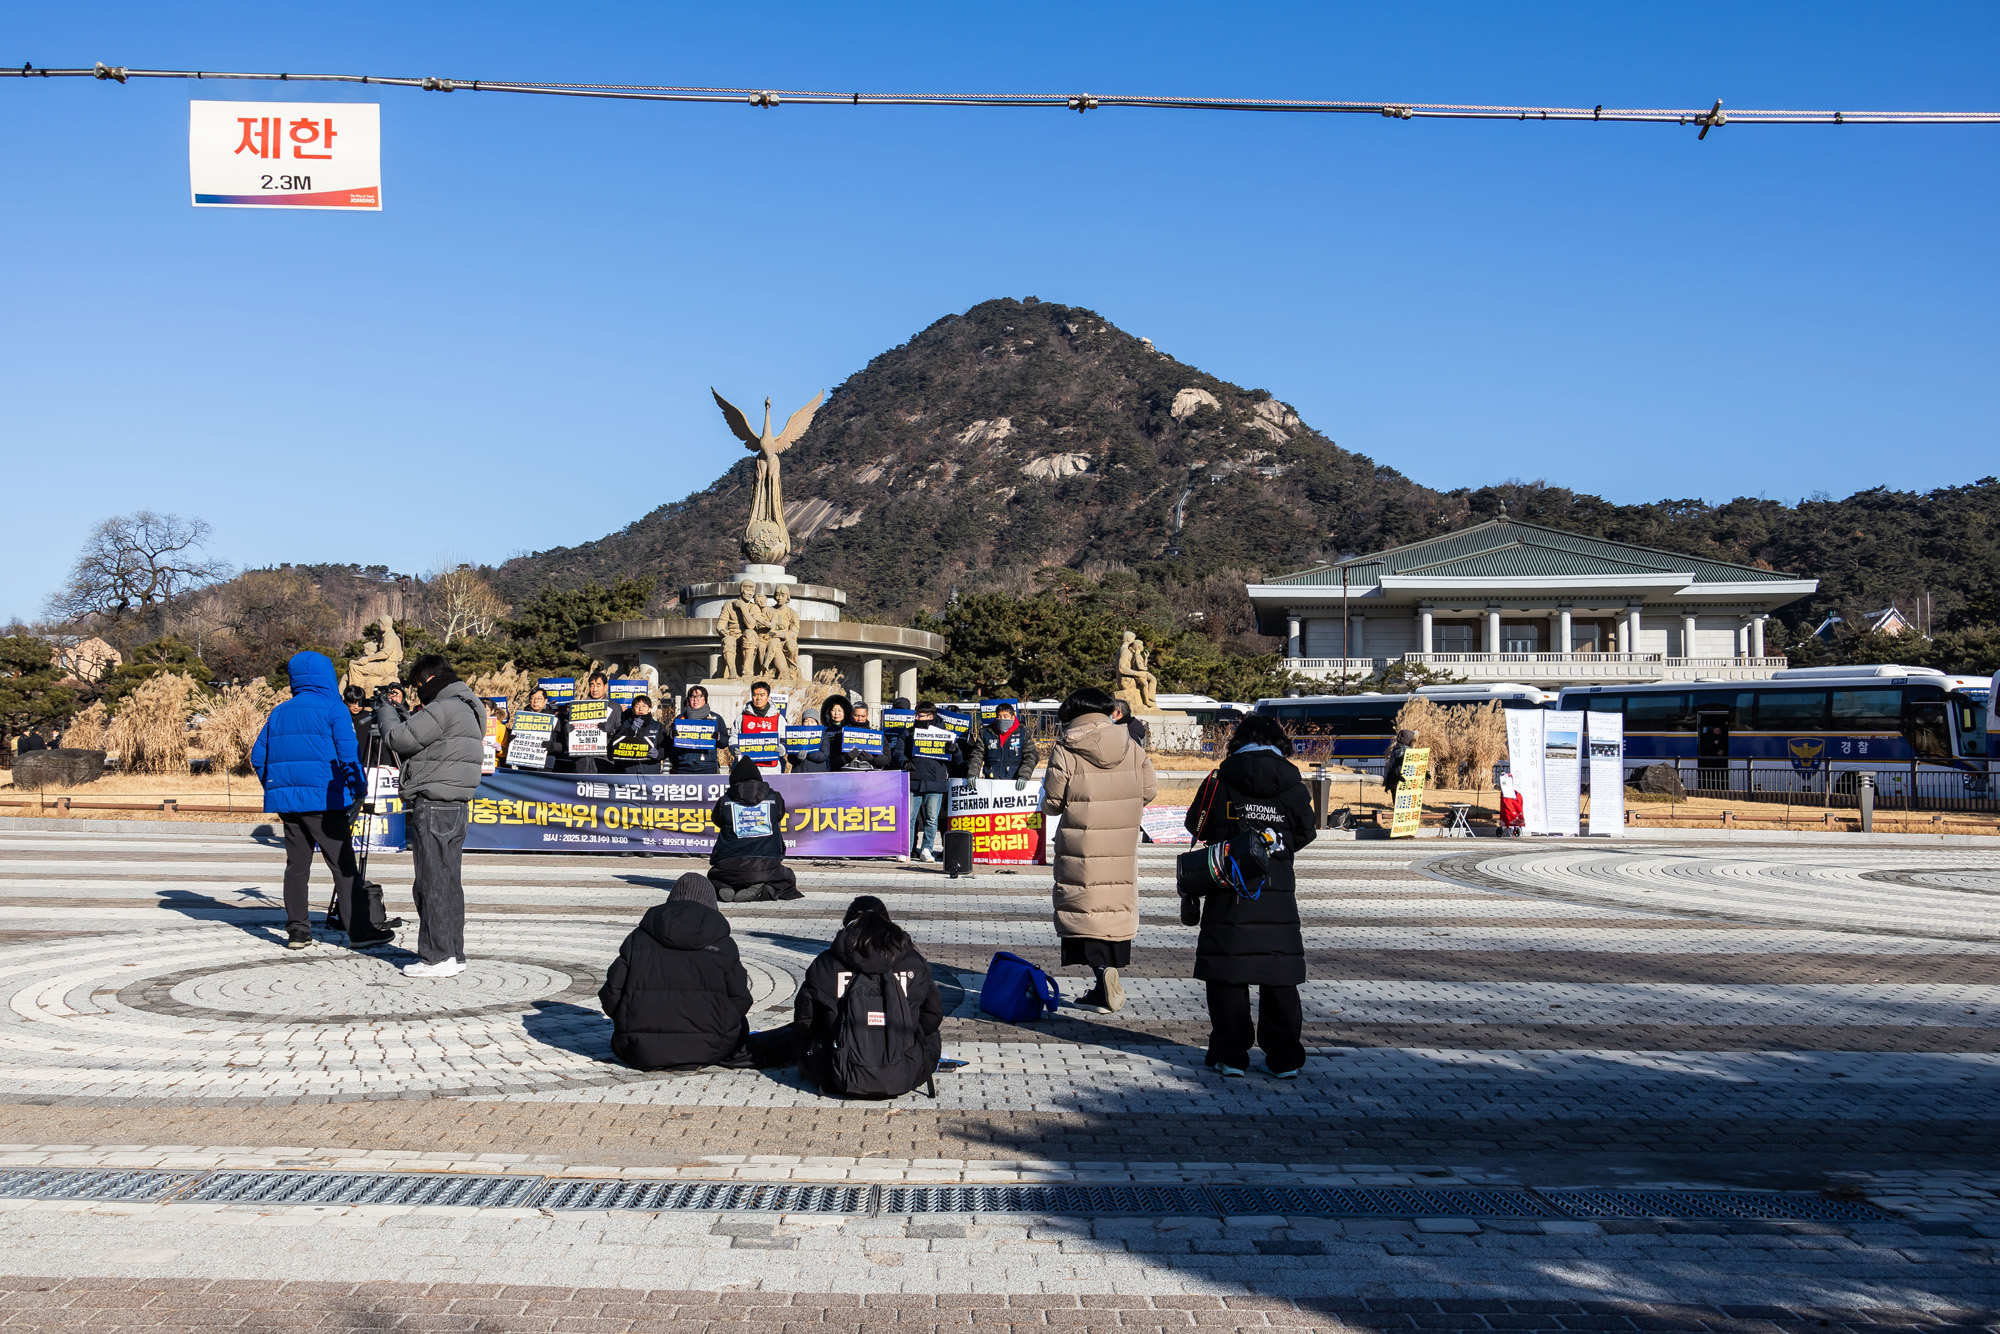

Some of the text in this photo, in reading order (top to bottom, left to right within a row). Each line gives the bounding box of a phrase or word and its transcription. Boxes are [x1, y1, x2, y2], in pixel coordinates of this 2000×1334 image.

[234, 117, 338, 160] 제한
[261, 174, 312, 191] 2.3M
[571, 710, 607, 721] 외침이다!
[675, 724, 716, 733] 발전비정규직
[786, 730, 823, 738] 발전비정규직
[843, 731, 883, 739] 발전비정규직
[739, 738, 778, 746] 발전비정규직
[576, 781, 610, 799] 해를
[614, 783, 648, 801] 넘긴
[651, 783, 702, 801] 위험의
[951, 784, 978, 797] 발전소
[951, 795, 1039, 812] 중대재해 사망사고
[1245, 803, 1278, 815] NATIONAL
[794, 805, 896, 832] 기자회견
[950, 813, 1042, 833] 위험의 외주화
[1196, 810, 1207, 832] Canon
[1247, 811, 1286, 823] EOGRAPHIC
[543, 833, 559, 842] 일시
[611, 836, 628, 844] 10:00
[686, 838, 709, 847] 분수대
[973, 834, 1029, 853] 단하라!
